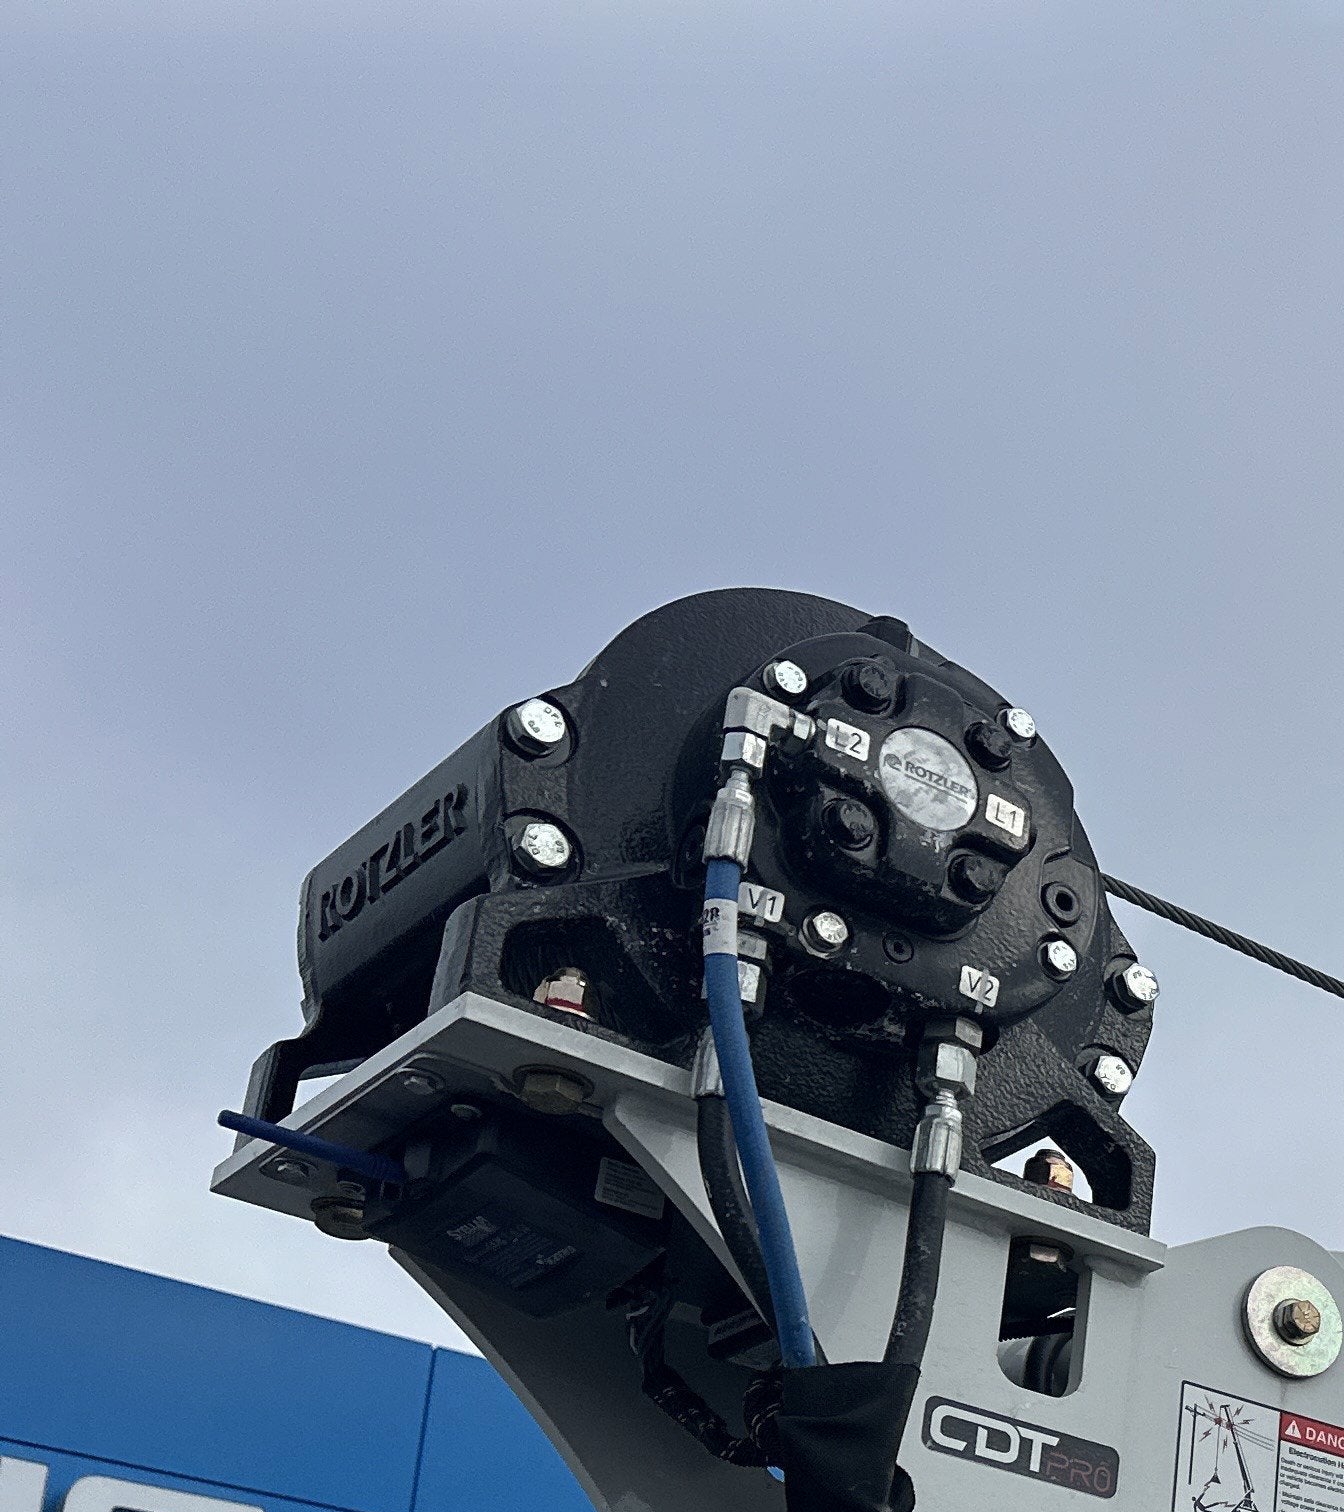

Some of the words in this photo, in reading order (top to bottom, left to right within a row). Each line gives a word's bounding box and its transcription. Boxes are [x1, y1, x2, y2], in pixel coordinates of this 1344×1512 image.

[834, 725, 862, 754] L2
[905, 762, 971, 798] ROTZLER
[995, 801, 1018, 831] L1
[318, 782, 469, 942] ROTZLER
[748, 887, 777, 916] V1
[966, 970, 994, 1002] V2
[929, 1404, 1060, 1473] CDT
